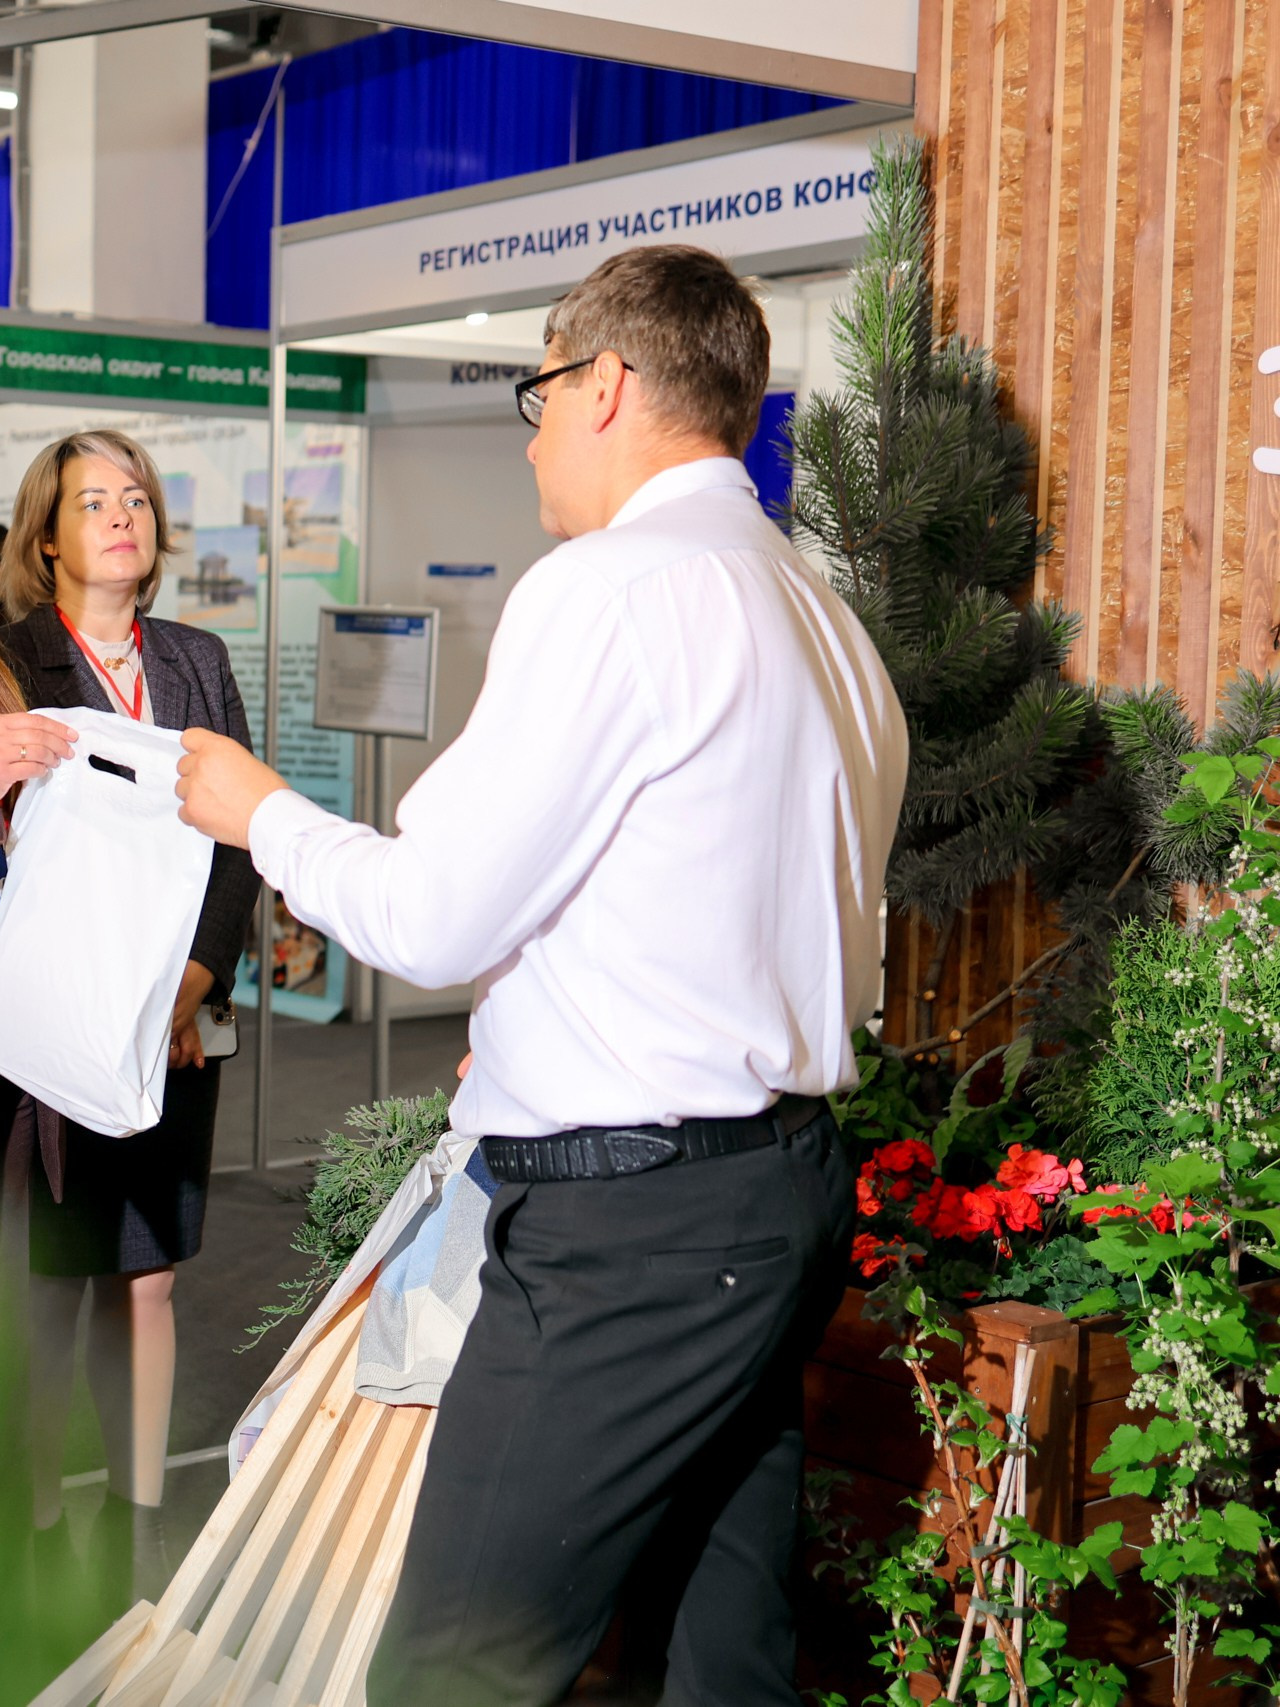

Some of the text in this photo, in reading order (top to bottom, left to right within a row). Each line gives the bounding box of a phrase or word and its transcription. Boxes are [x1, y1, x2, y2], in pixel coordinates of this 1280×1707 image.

[420, 222, 588, 273] РЕГИСТРАЦИЯ
[599, 186, 782, 242] УЧАСТНИКОВ
[107, 358, 164, 379] округ
[187, 364, 244, 385] город
[248, 366, 342, 392] Каышин
